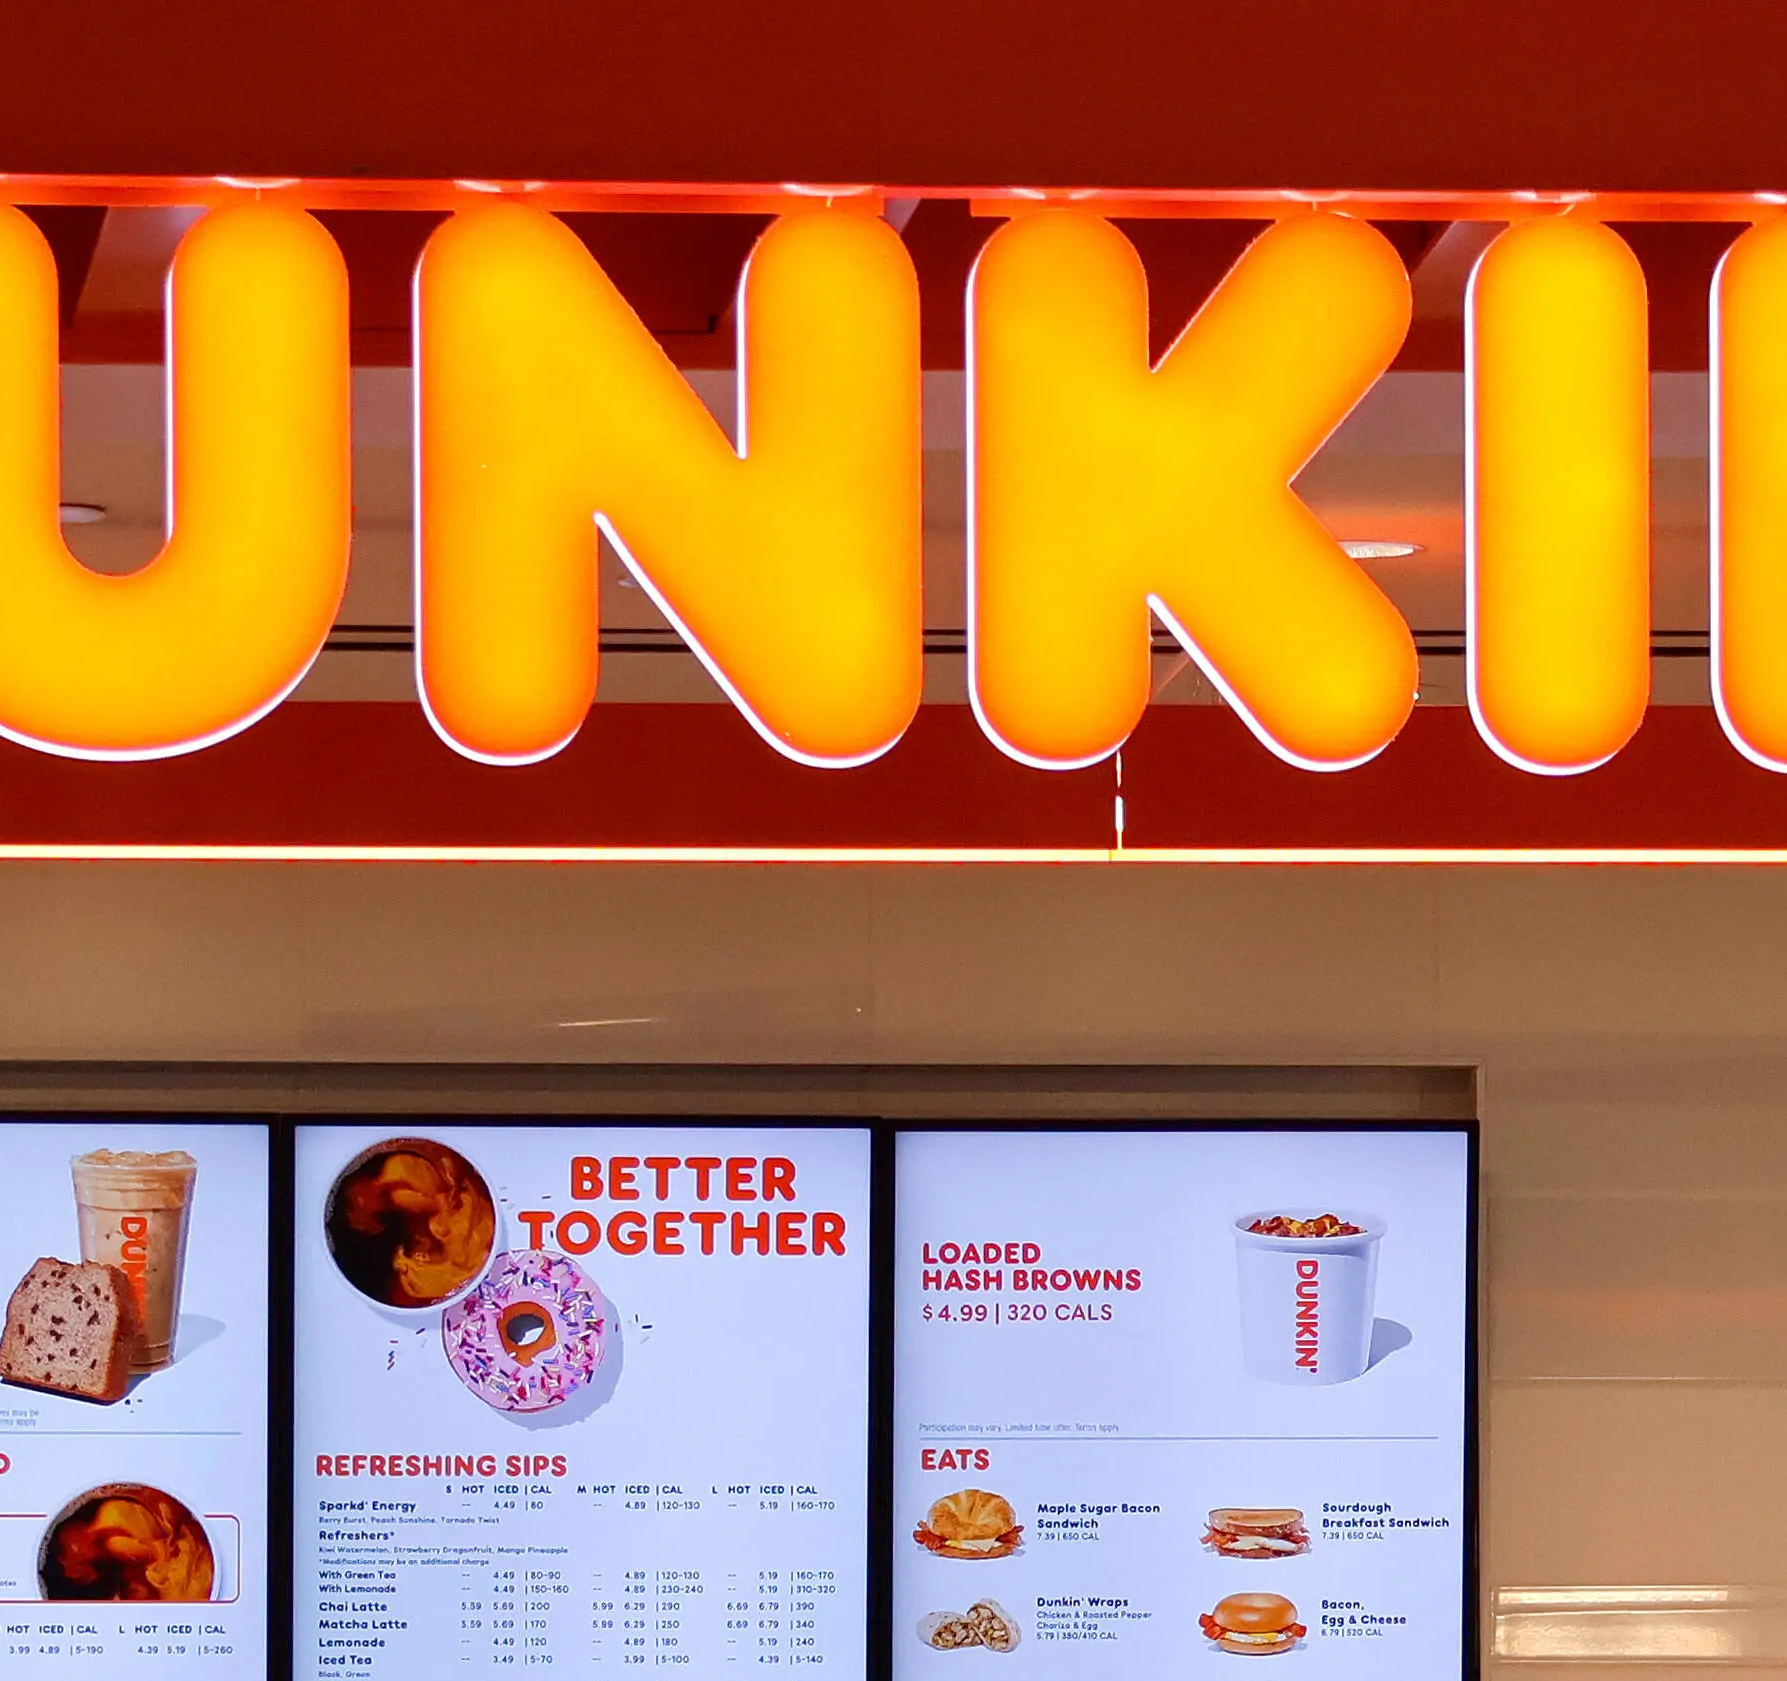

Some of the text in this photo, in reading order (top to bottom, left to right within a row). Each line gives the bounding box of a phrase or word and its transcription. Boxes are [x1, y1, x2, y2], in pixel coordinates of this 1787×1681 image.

[571, 1157, 800, 1205] BETTER
[517, 1210, 847, 1257] TOGETHER
[923, 1243, 1042, 1266] LOADED
[923, 1267, 1142, 1292] HASH BROWNS
[1008, 1305, 1048, 1322] 320
[1055, 1304, 1113, 1322] CALS
[1291, 1255, 1323, 1377] DUNKIN'
[317, 1455, 568, 1478] REFRESHING SIPS
[922, 1449, 990, 1472] EATS
[1038, 1504, 1161, 1517] Maple Sugar Bacon
[1038, 1519, 1100, 1530] Sandwich
[319, 1603, 388, 1613] Chai Latte
[1038, 1597, 1130, 1610] Dunkin' Wraps
